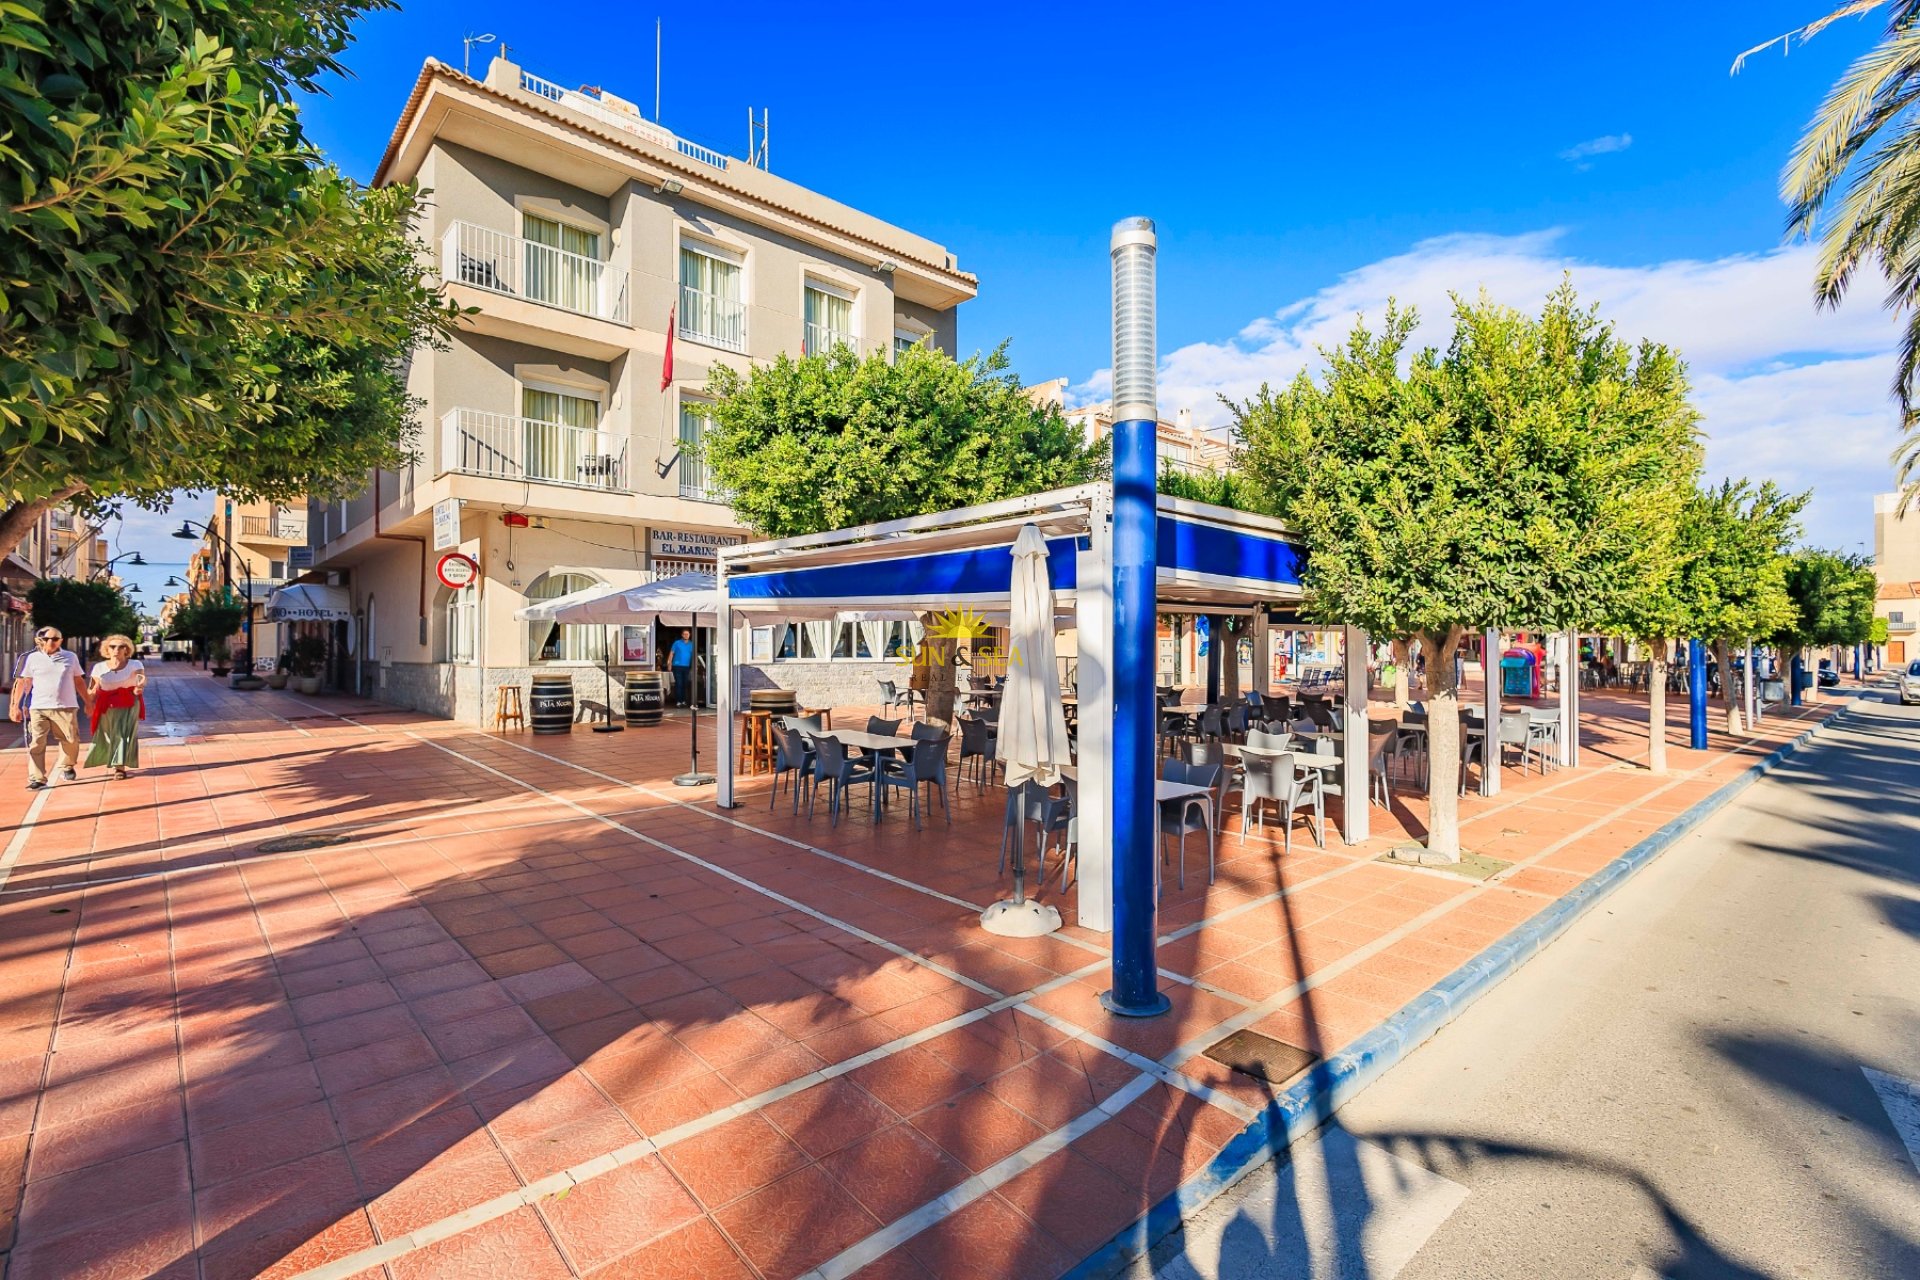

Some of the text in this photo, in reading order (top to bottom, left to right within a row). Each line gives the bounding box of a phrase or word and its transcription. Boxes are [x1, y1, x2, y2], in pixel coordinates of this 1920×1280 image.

[653, 530, 738, 546] BAR-RESTAURANTE
[661, 543, 674, 553] EL
[298, 609, 333, 617] HOTEL
